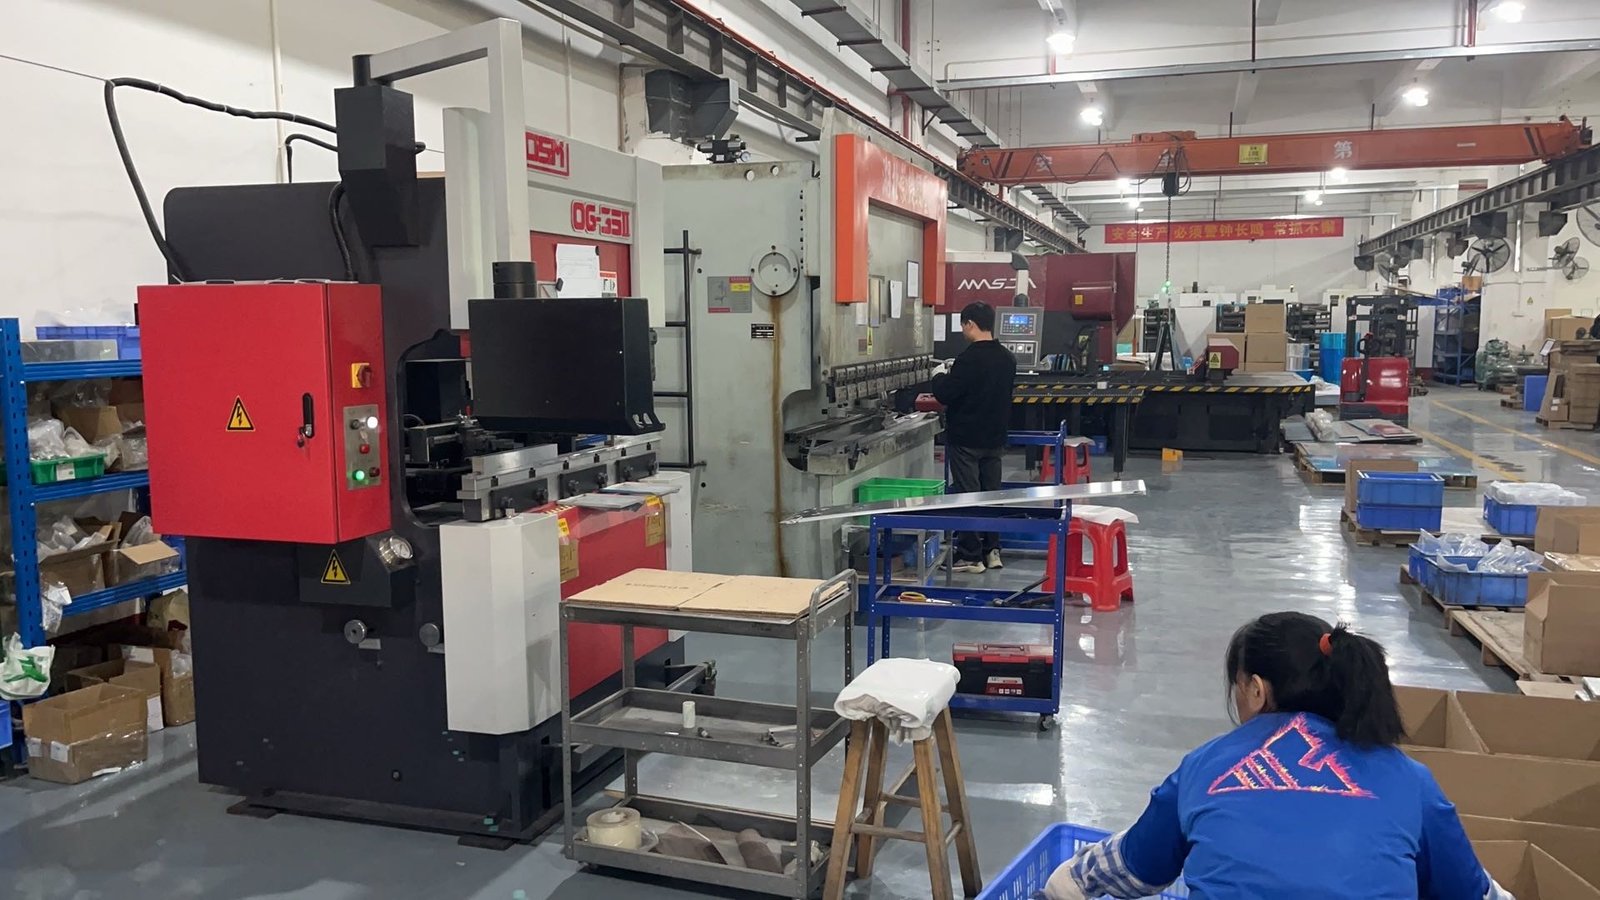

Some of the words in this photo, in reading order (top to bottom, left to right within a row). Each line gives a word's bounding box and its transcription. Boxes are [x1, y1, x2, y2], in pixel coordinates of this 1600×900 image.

[1334, 140, 1353, 159] 第
[1111, 226, 1169, 240] 安全生产
[1273, 220, 1336, 236] 常抓不懈
